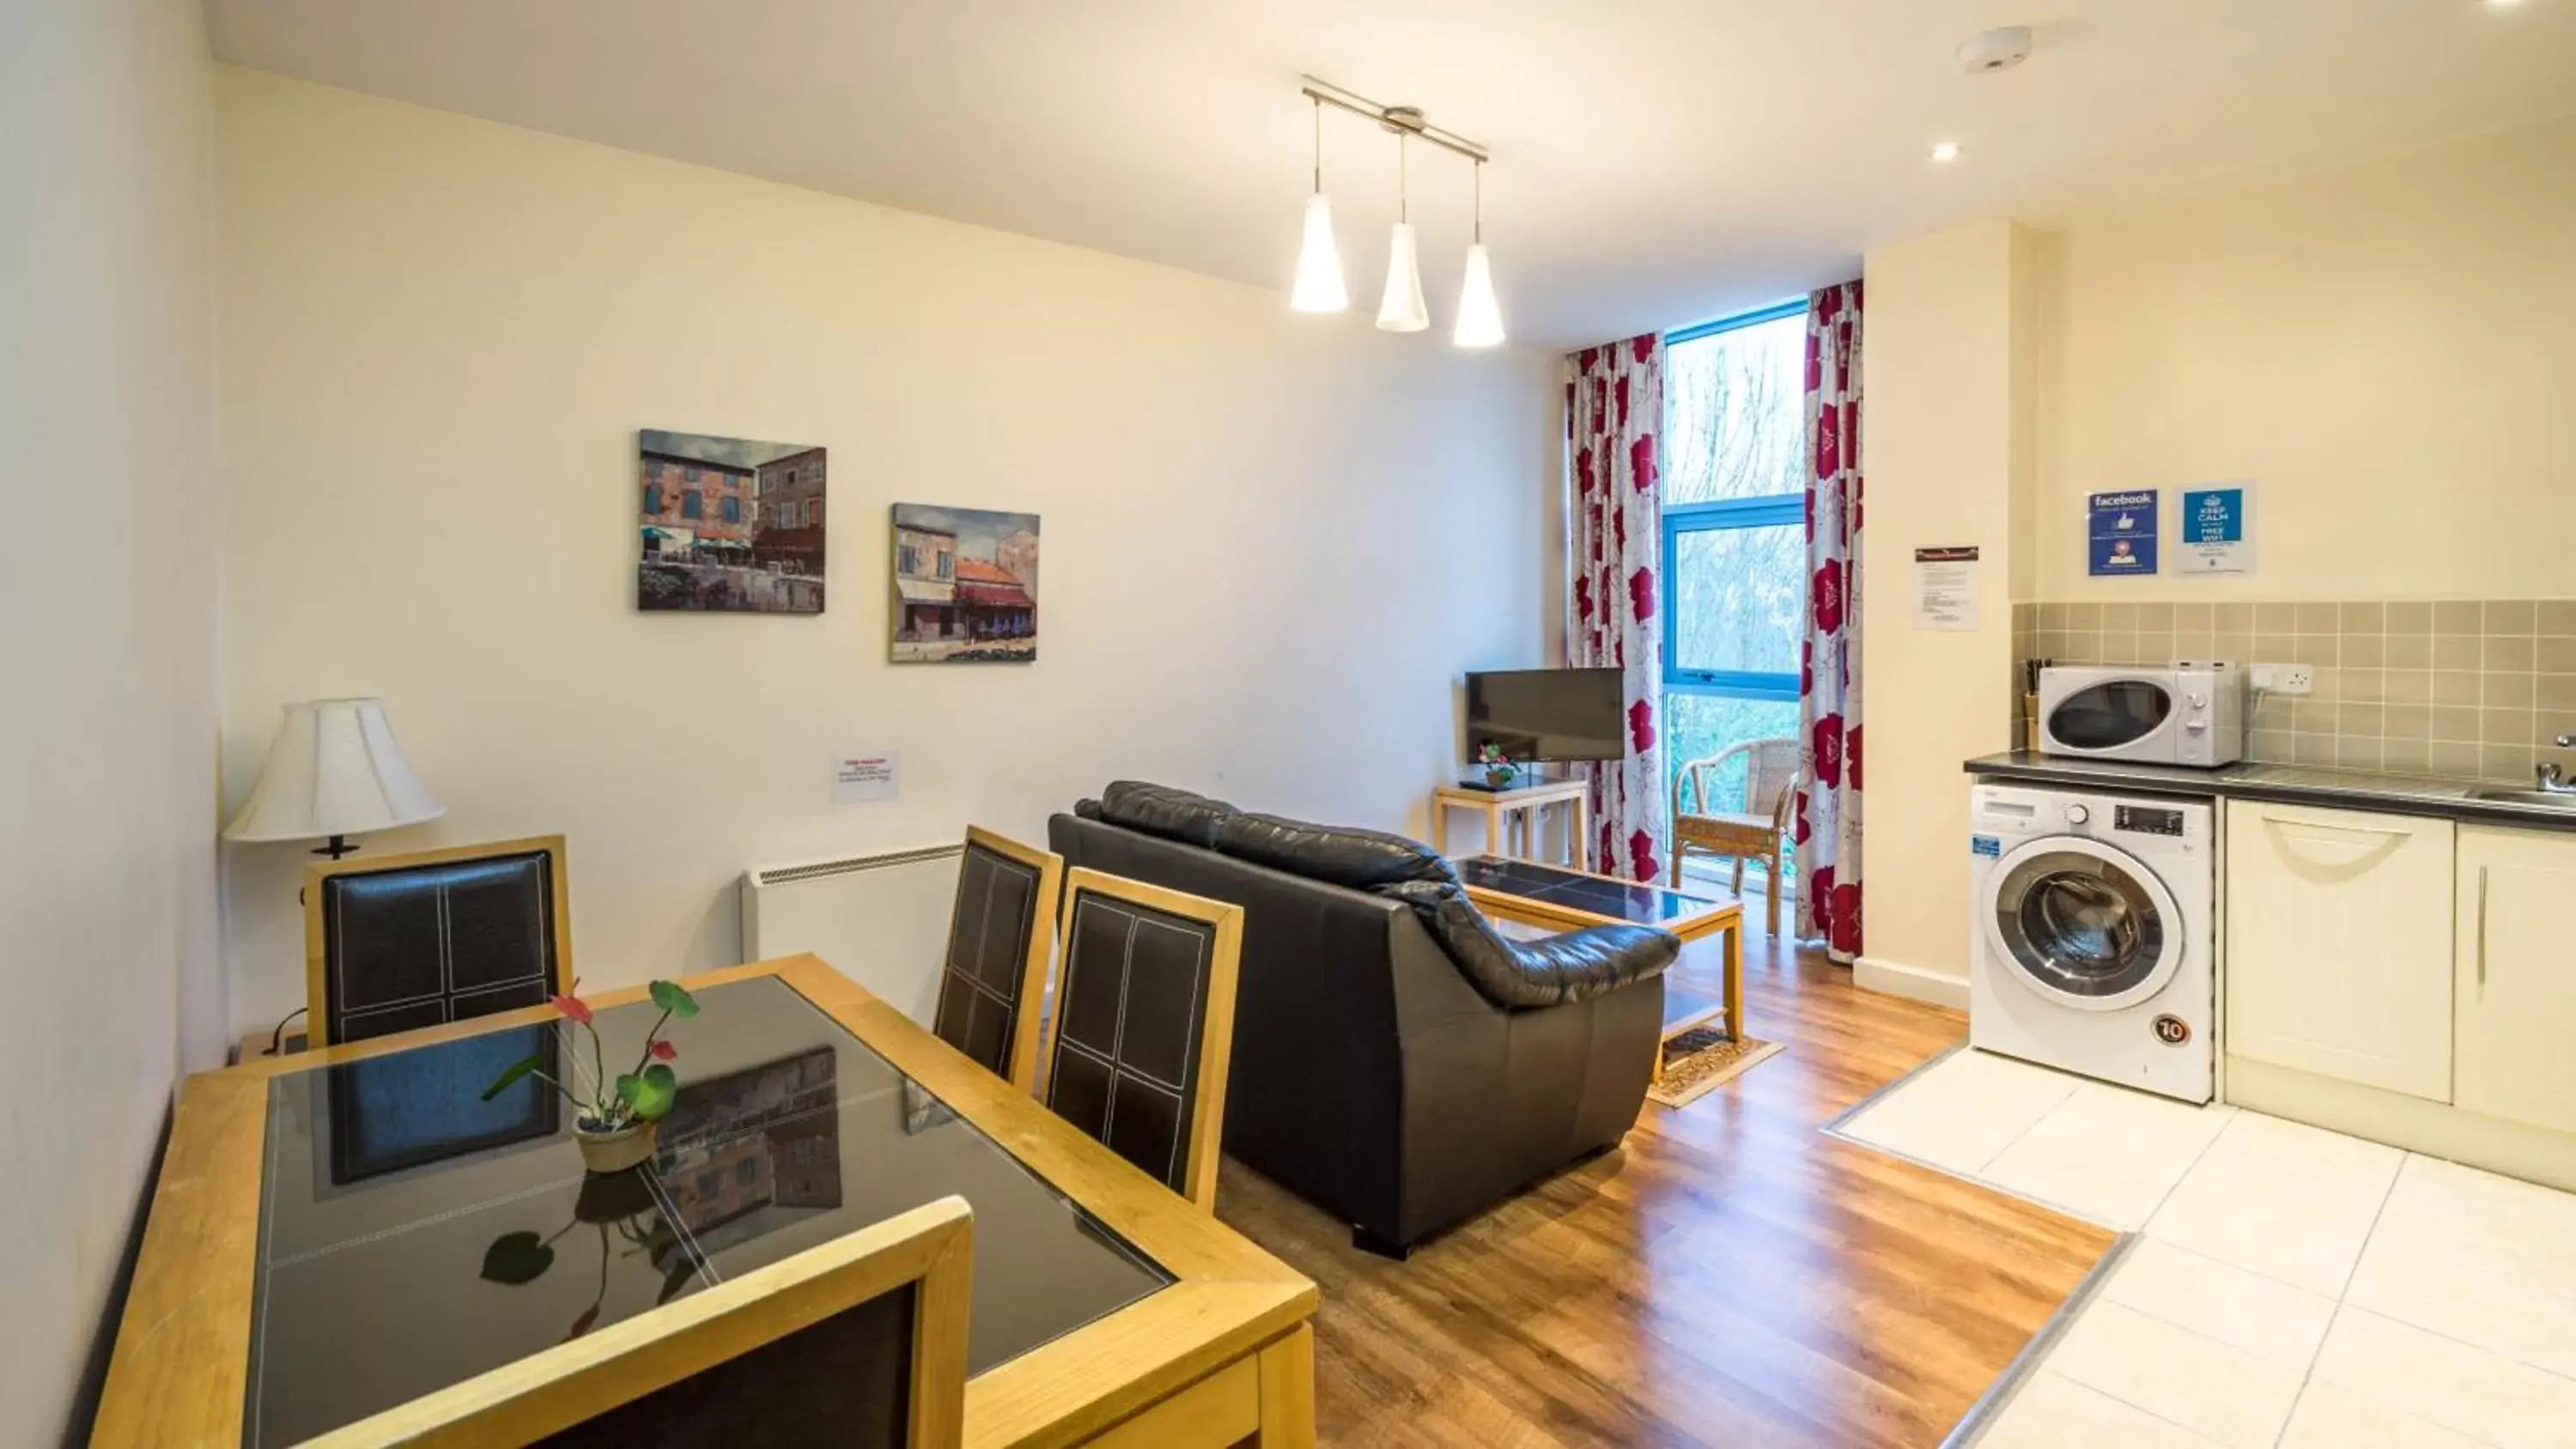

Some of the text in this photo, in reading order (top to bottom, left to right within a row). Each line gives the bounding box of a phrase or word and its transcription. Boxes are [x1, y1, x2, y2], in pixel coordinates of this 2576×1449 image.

[2095, 493, 2152, 507] facebook
[2198, 513, 2228, 522] CALM
[2159, 1022, 2184, 1038] 10
